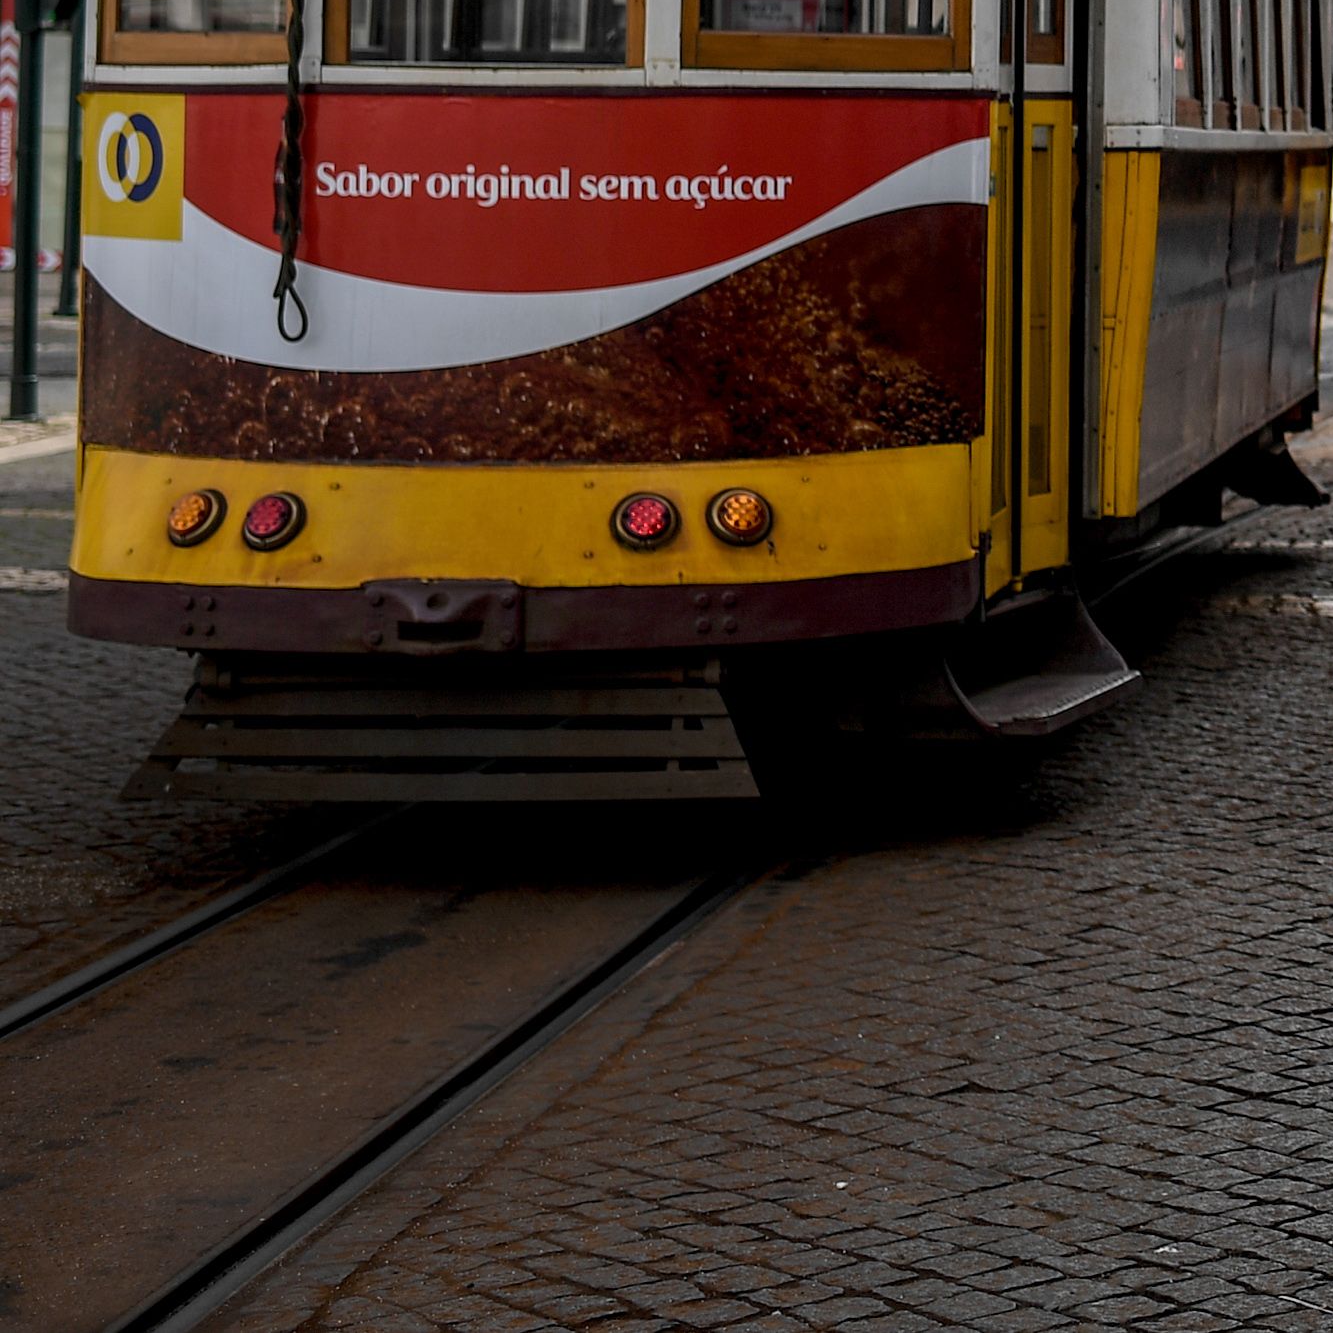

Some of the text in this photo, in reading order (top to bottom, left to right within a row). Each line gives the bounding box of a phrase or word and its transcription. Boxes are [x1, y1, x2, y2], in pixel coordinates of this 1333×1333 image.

[315, 161, 792, 209] Sabor original sem açúcar
